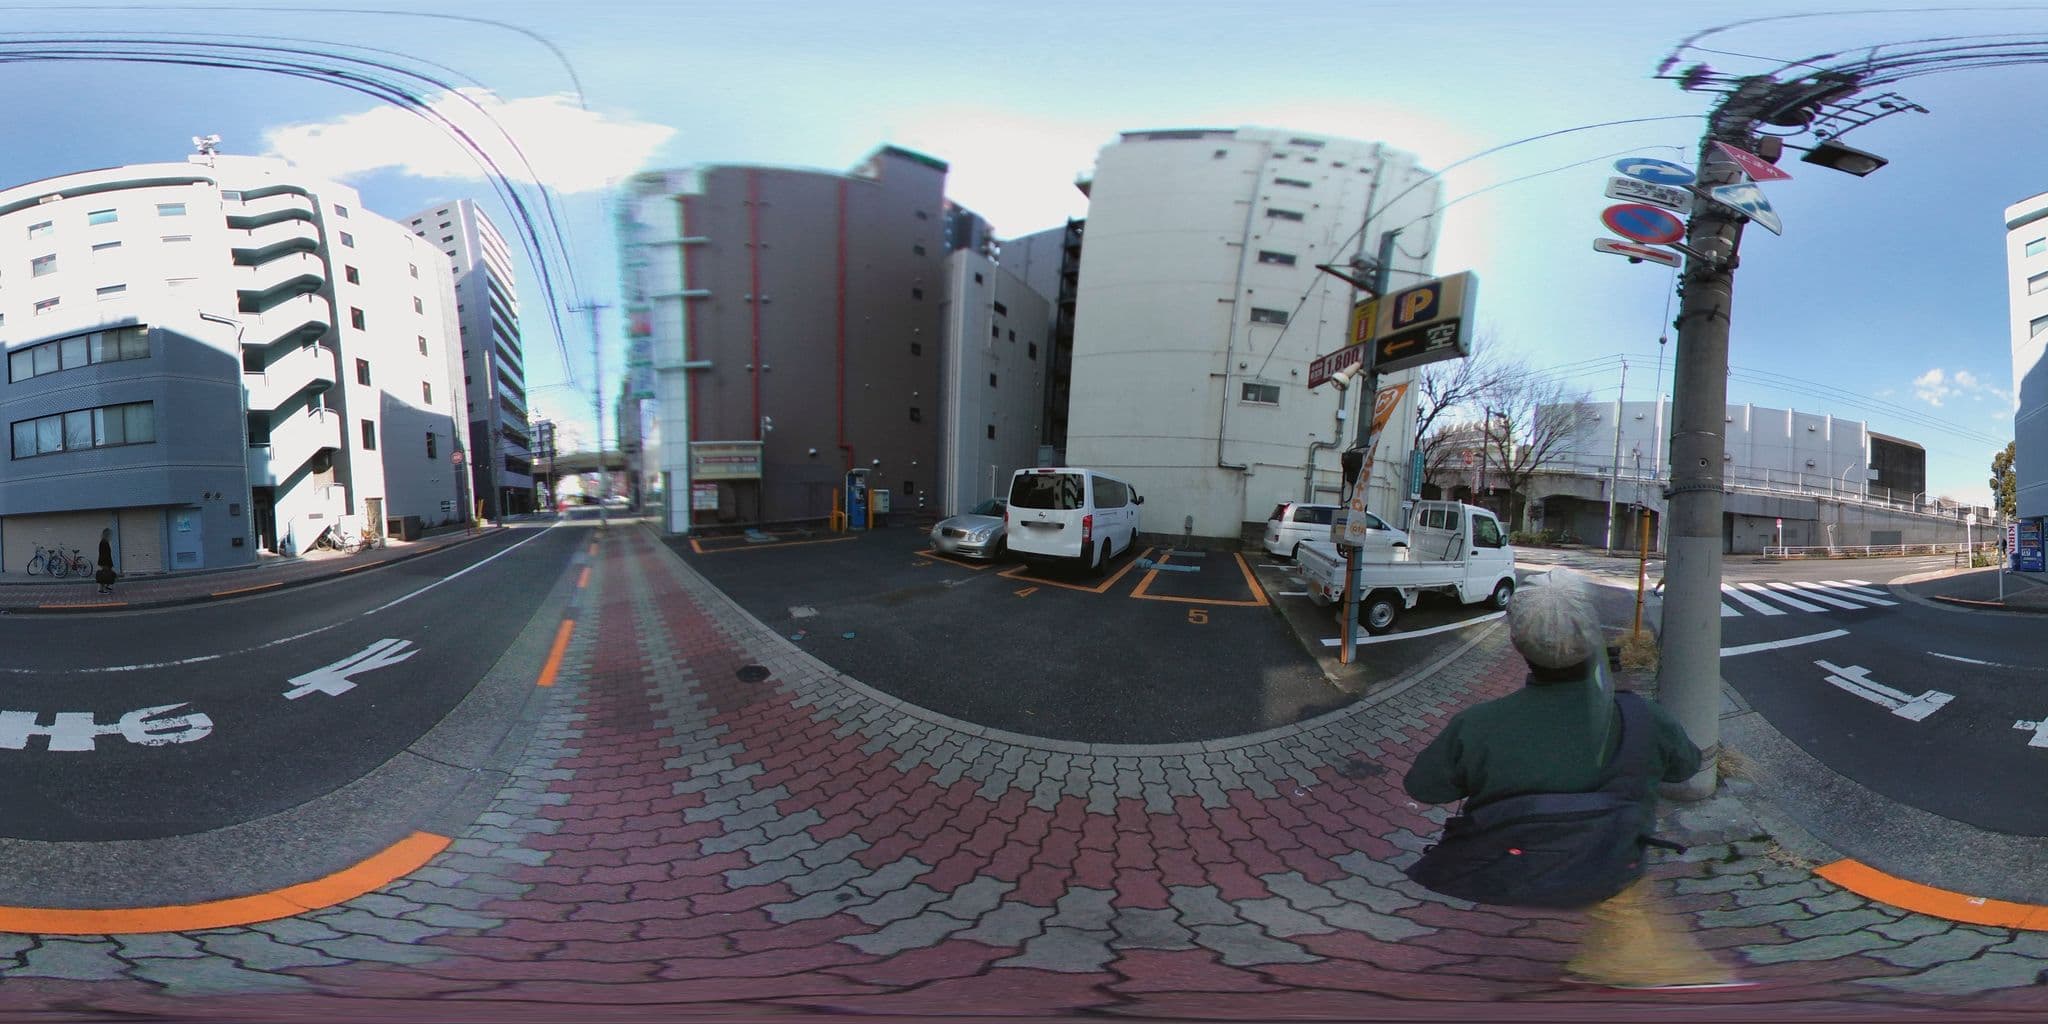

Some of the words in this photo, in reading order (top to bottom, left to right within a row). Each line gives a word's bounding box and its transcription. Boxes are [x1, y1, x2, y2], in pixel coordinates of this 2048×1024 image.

[1736, 154, 1780, 177] 止まれ
[1616, 187, 1683, 204] 一方通行
[1400, 288, 1433, 322] P
[1425, 323, 1456, 351] 空
[2008, 525, 2017, 555] KIRIN
[1188, 609, 1209, 624] 5
